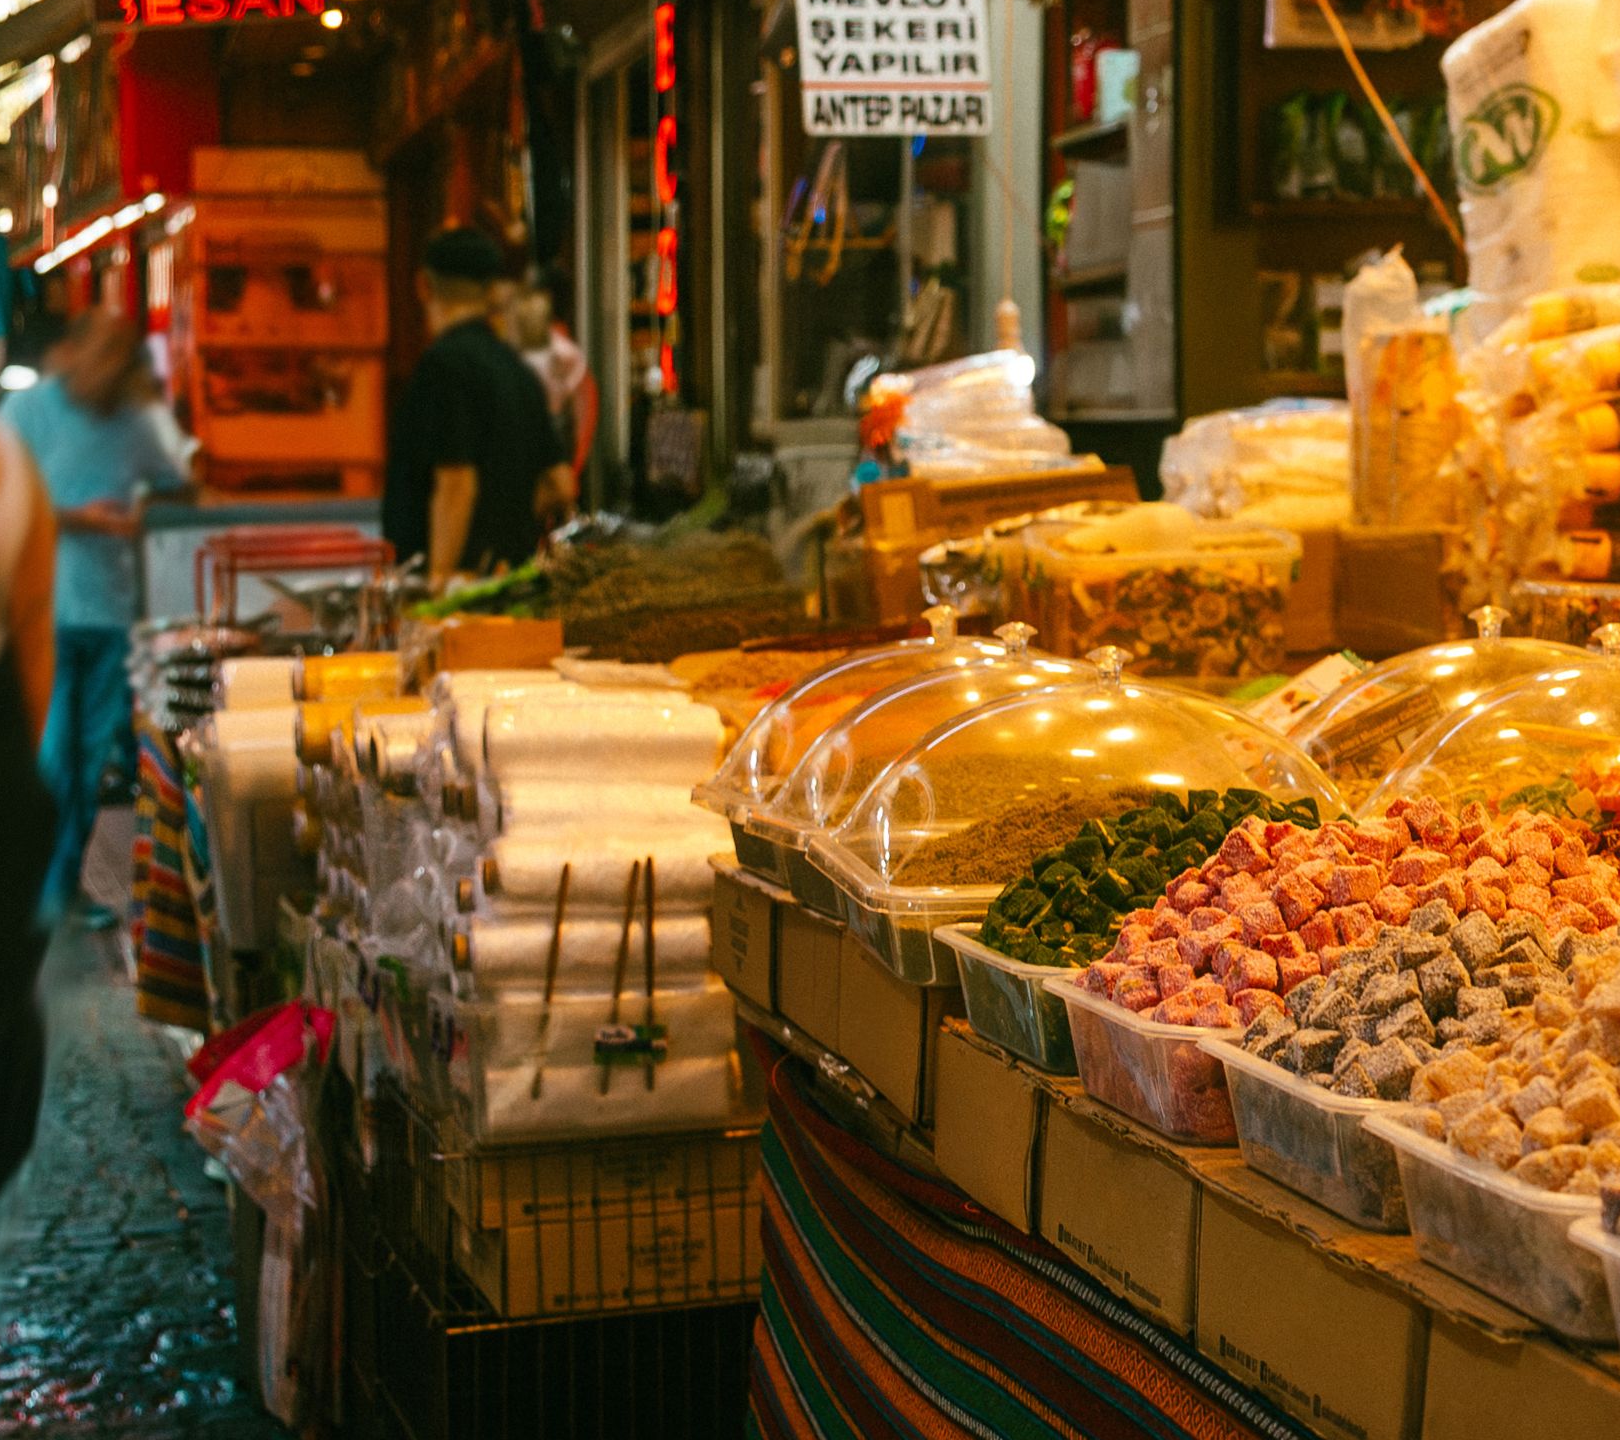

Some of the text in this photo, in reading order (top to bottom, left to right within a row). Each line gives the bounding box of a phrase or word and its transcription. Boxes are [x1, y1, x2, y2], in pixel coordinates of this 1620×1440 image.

[811, 12, 977, 44] ŞEKERİ
[814, 51, 980, 75] YAPILIR
[813, 94, 892, 126] ANTEP
